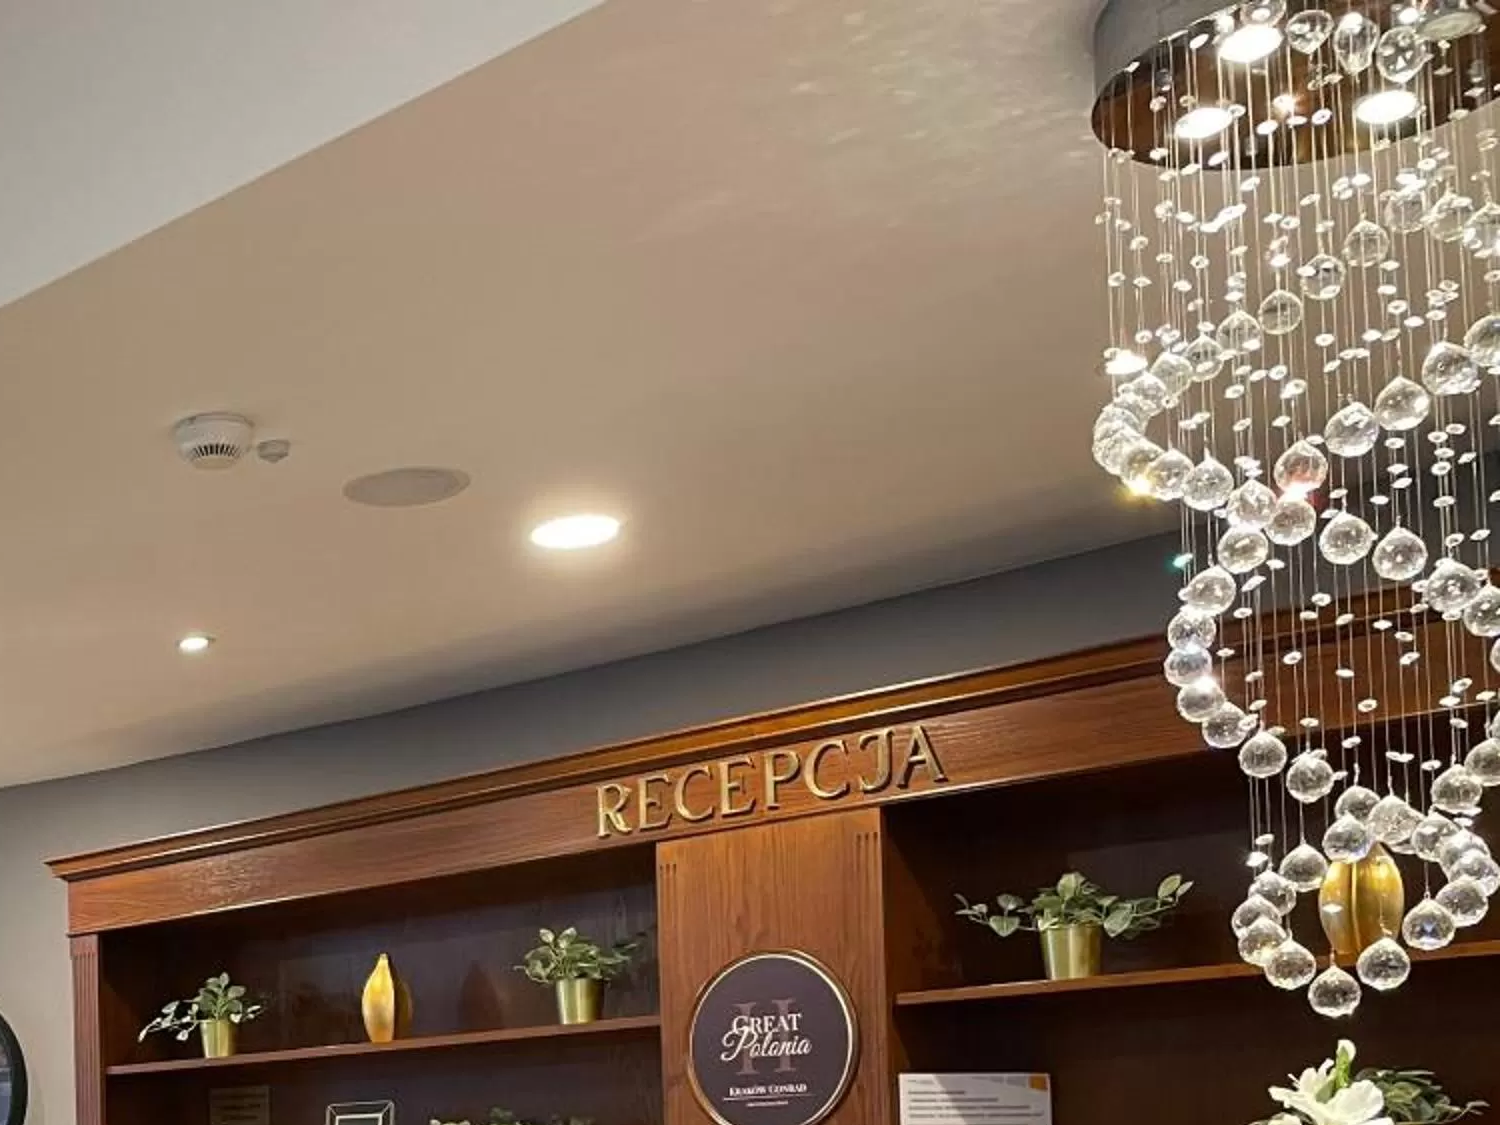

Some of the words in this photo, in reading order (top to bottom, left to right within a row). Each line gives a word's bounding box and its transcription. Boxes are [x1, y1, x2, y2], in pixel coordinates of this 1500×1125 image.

[596, 725, 949, 838] RECEPCJA
[732, 1012, 803, 1034] GREAT
[720, 1025, 813, 1062] Polonia
